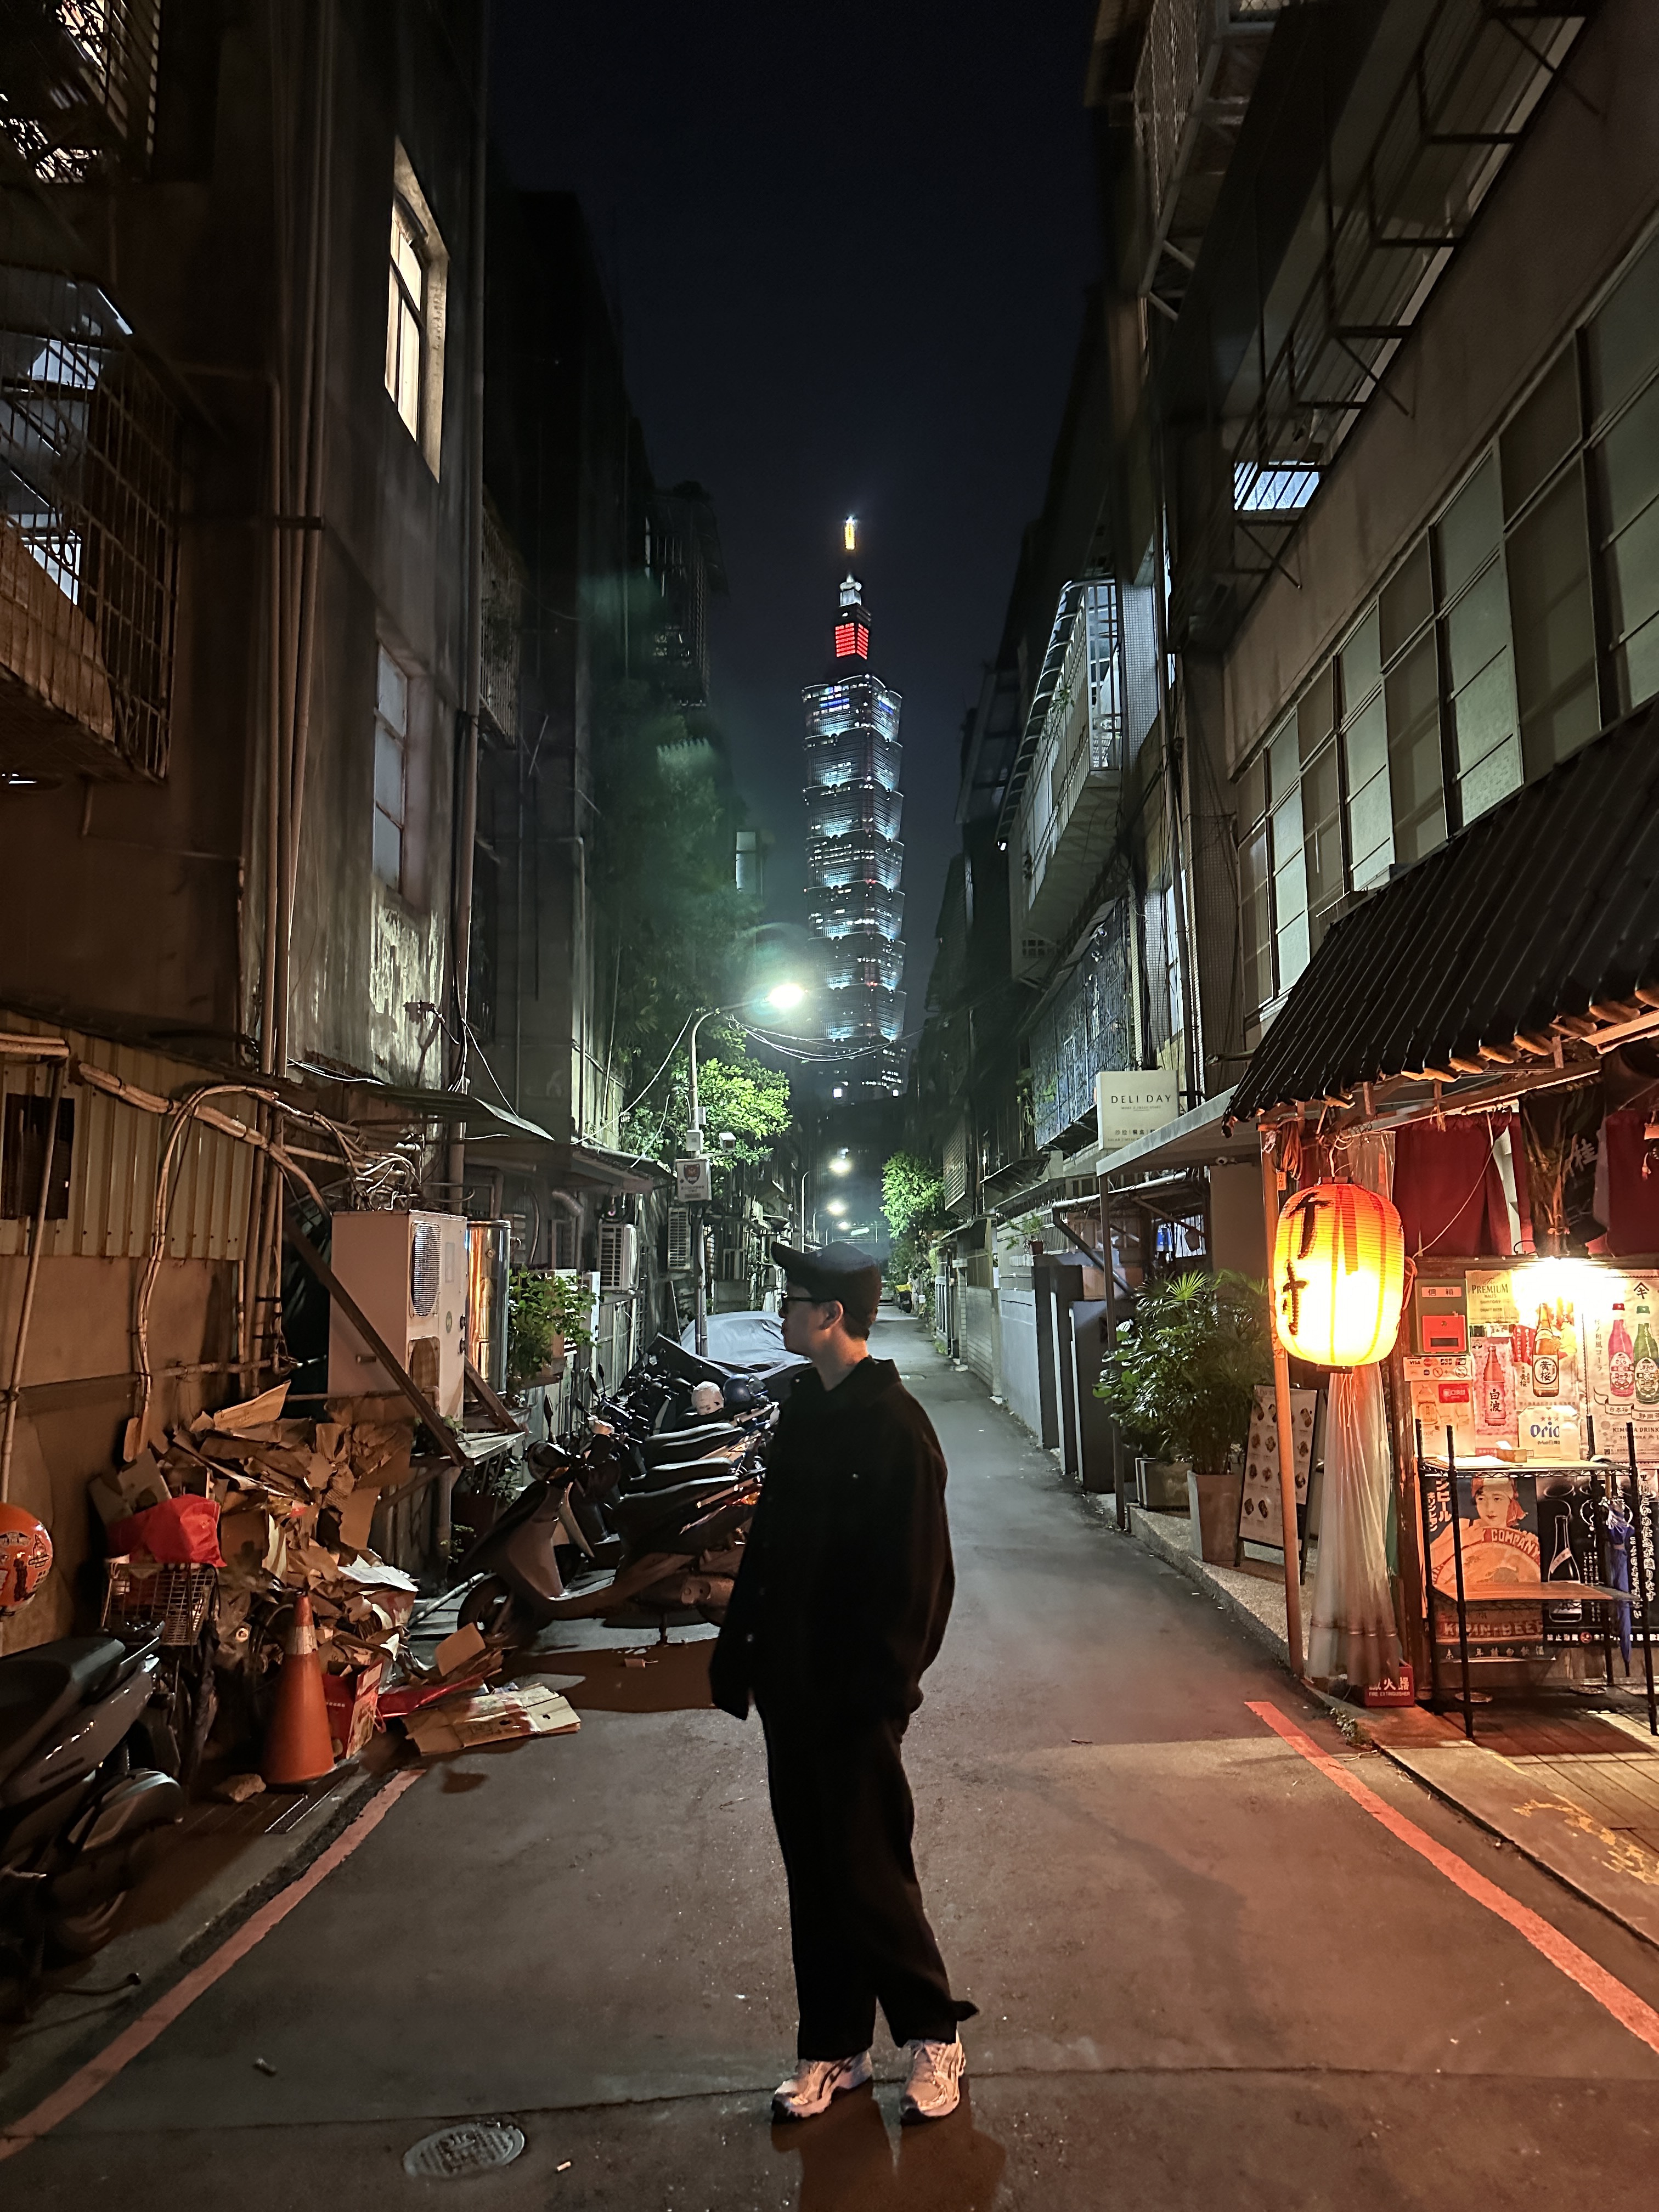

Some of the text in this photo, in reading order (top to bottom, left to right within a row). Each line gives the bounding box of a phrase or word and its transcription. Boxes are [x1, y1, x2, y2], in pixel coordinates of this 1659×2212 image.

[1111, 1094, 1171, 1104] DELI DAY
[1471, 1284, 1509, 1294] PREMIUM
[1489, 1388, 1502, 1412] 白波
[1491, 1529, 1540, 1558] COMPANY
